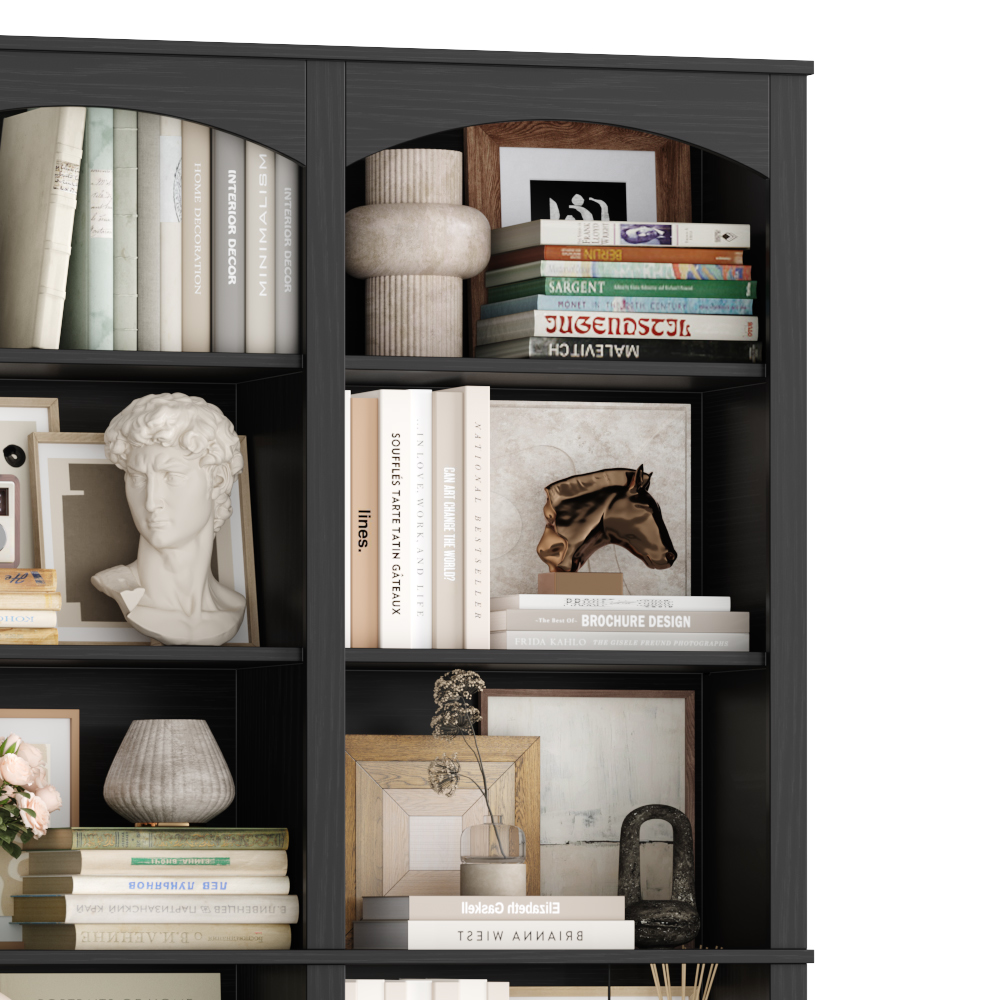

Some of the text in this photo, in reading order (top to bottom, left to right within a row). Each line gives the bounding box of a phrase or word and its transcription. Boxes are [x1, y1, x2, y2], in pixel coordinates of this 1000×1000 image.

[228, 170, 236, 285] INTERIOR DECOR
[258, 154, 267, 296] MINIMALISM
[584, 249, 622, 261] BERLIN
[549, 281, 605, 294] SARGENT
[545, 315, 691, 336] JUGENDSTIL
[549, 344, 639, 358] MALEVITCH
[358, 510, 371, 552] lines.
[392, 433, 404, 615] SOUFFLÉS TARTE TATIN GÂTEAUX
[444, 467, 455, 582] CAN ART CHANGE THE WORLD?
[582, 614, 691, 628] BROCHURE DESIGN
[514, 638, 546, 646] FRIDA
[550, 638, 586, 646] KAHLO
[129, 882, 228, 890] ЛЕВ ЛУКЬЯНОВ
